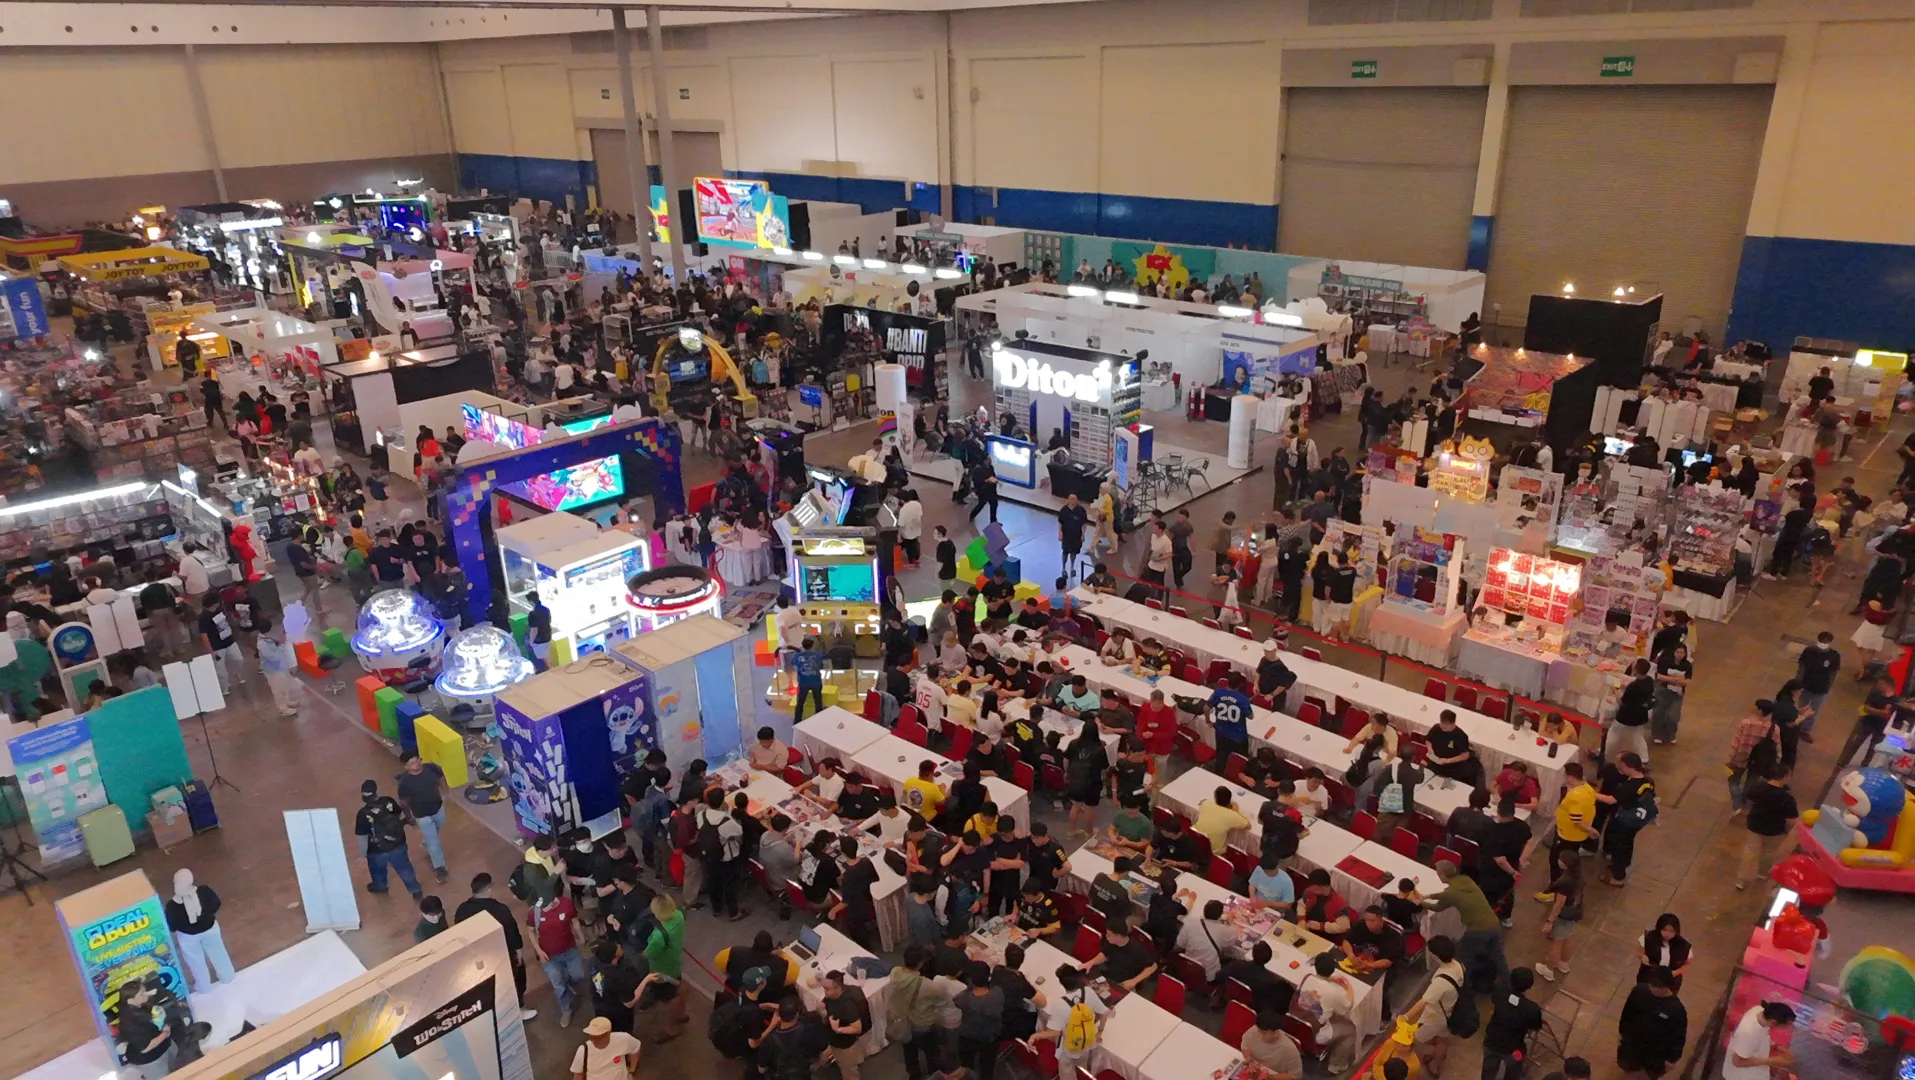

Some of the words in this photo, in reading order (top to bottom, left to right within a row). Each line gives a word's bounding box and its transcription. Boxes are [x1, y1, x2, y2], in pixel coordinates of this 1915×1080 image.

[104, 266, 145, 280] JOYTOY
[162, 261, 200, 273] JOYTOY
[1217, 702, 1241, 723] 20
